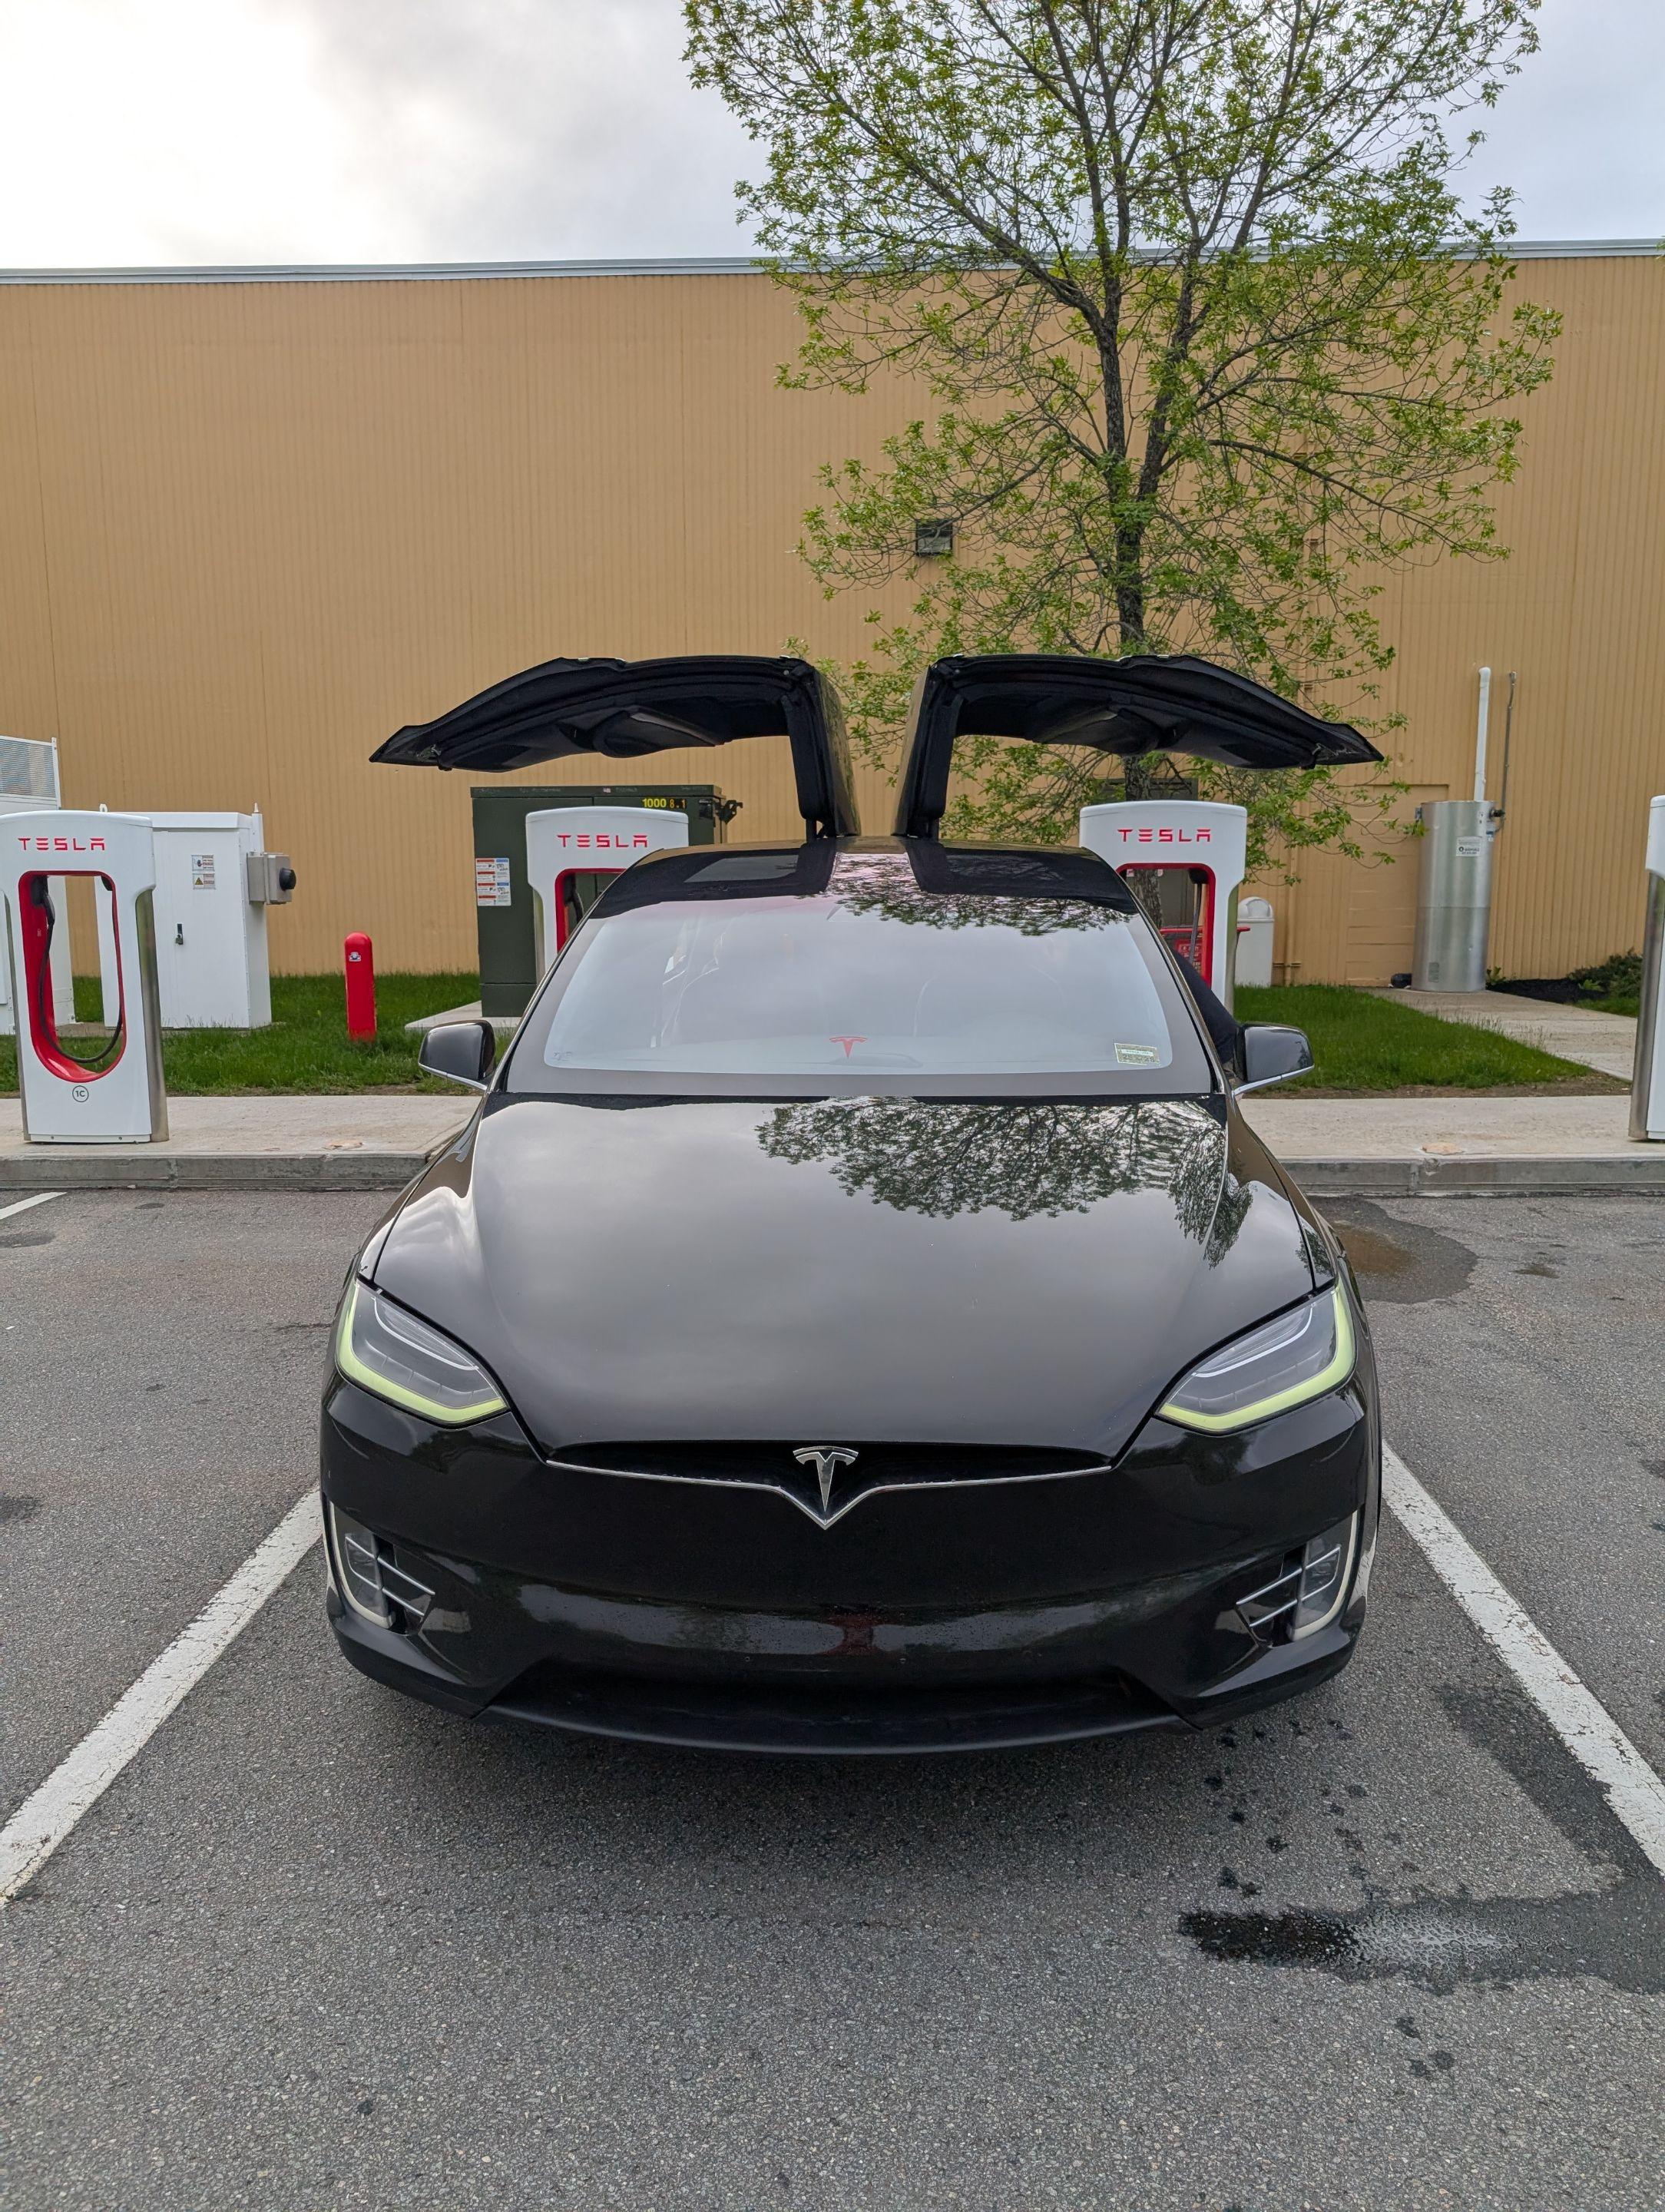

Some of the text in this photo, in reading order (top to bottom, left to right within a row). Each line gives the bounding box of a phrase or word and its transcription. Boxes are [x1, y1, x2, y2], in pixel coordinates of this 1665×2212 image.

[642, 798, 667, 808] 1000
[556, 834, 648, 848] TESLA
[1117, 829, 1211, 842] TESLA
[18, 837, 105, 851] TESLA
